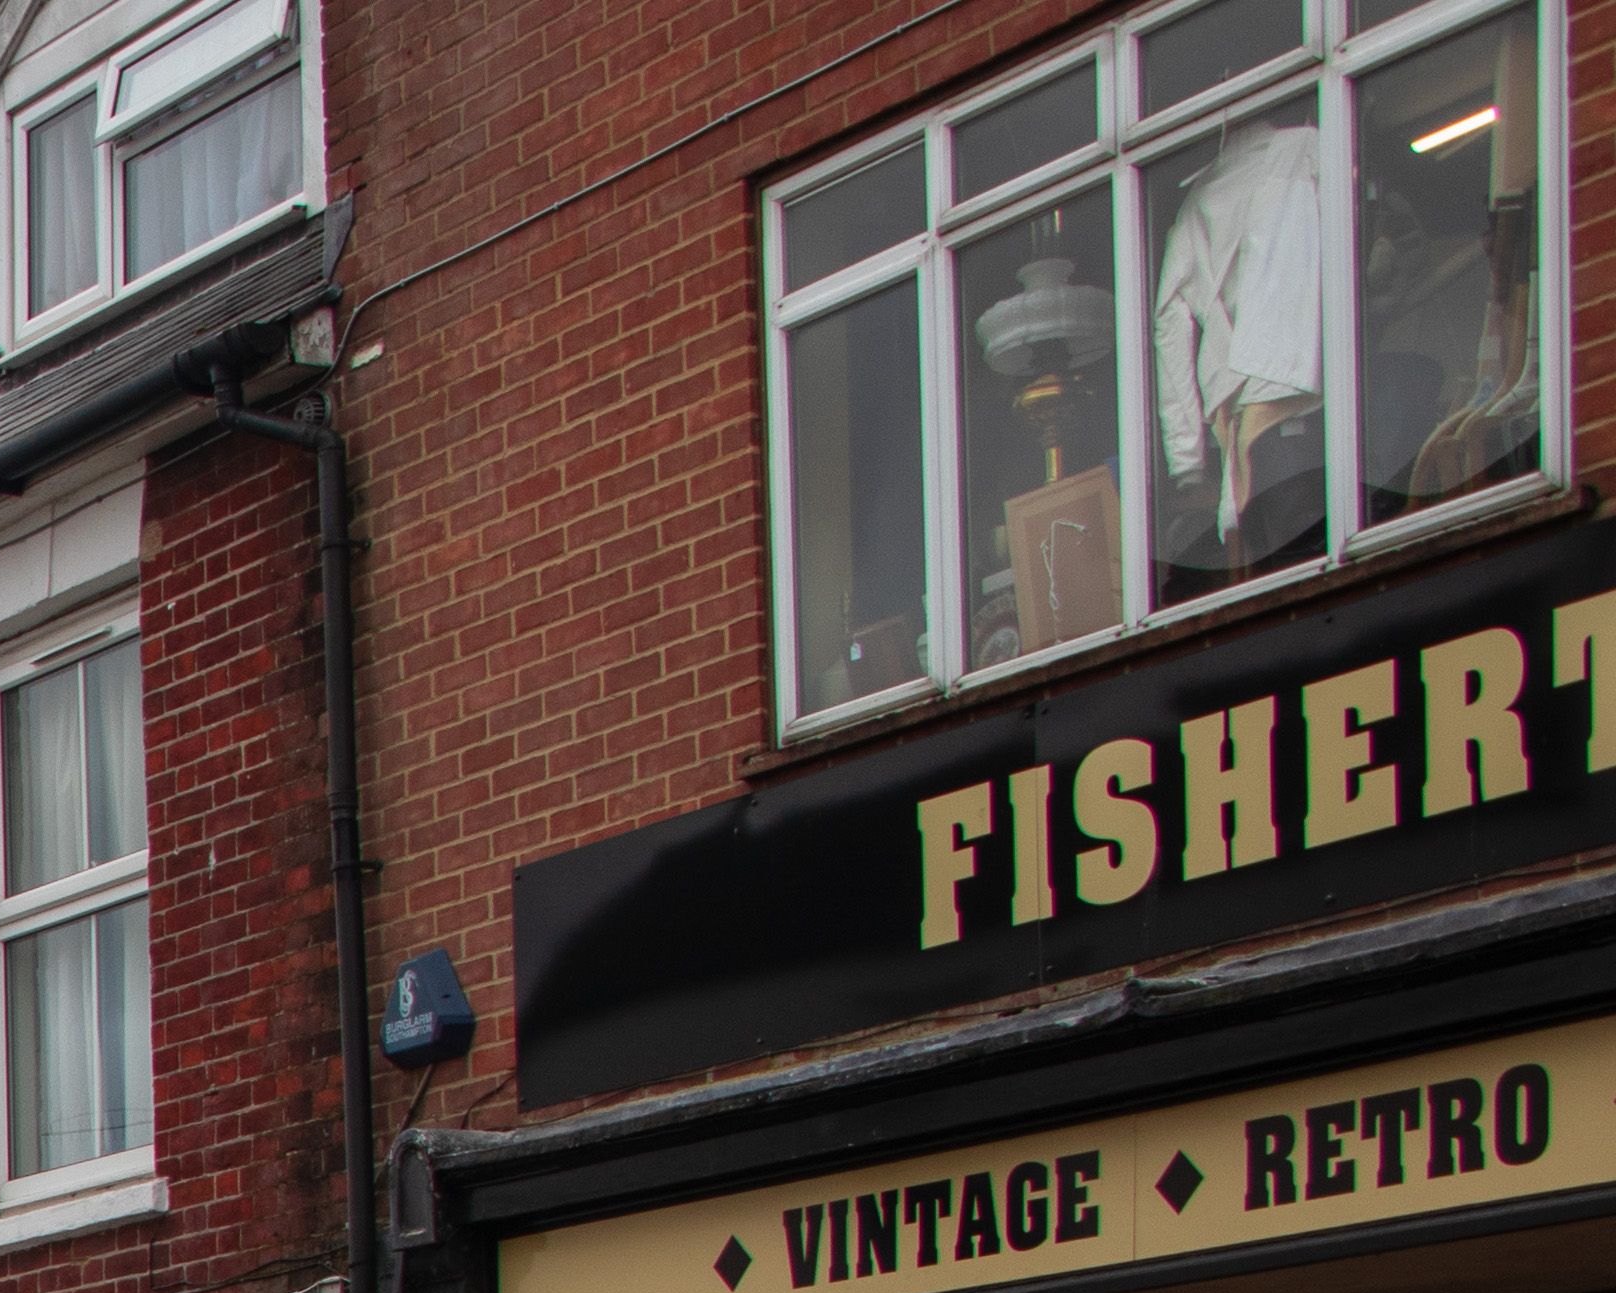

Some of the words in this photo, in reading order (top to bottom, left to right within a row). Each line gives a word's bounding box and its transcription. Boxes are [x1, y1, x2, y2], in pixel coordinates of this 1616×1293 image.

[385, 1011, 433, 1034] BURGLARM
[385, 1024, 433, 1044] SOUTHAMPTON
[782, 1149, 1100, 1290] VINTAGE
[1244, 1062, 1551, 1212] RETRO
